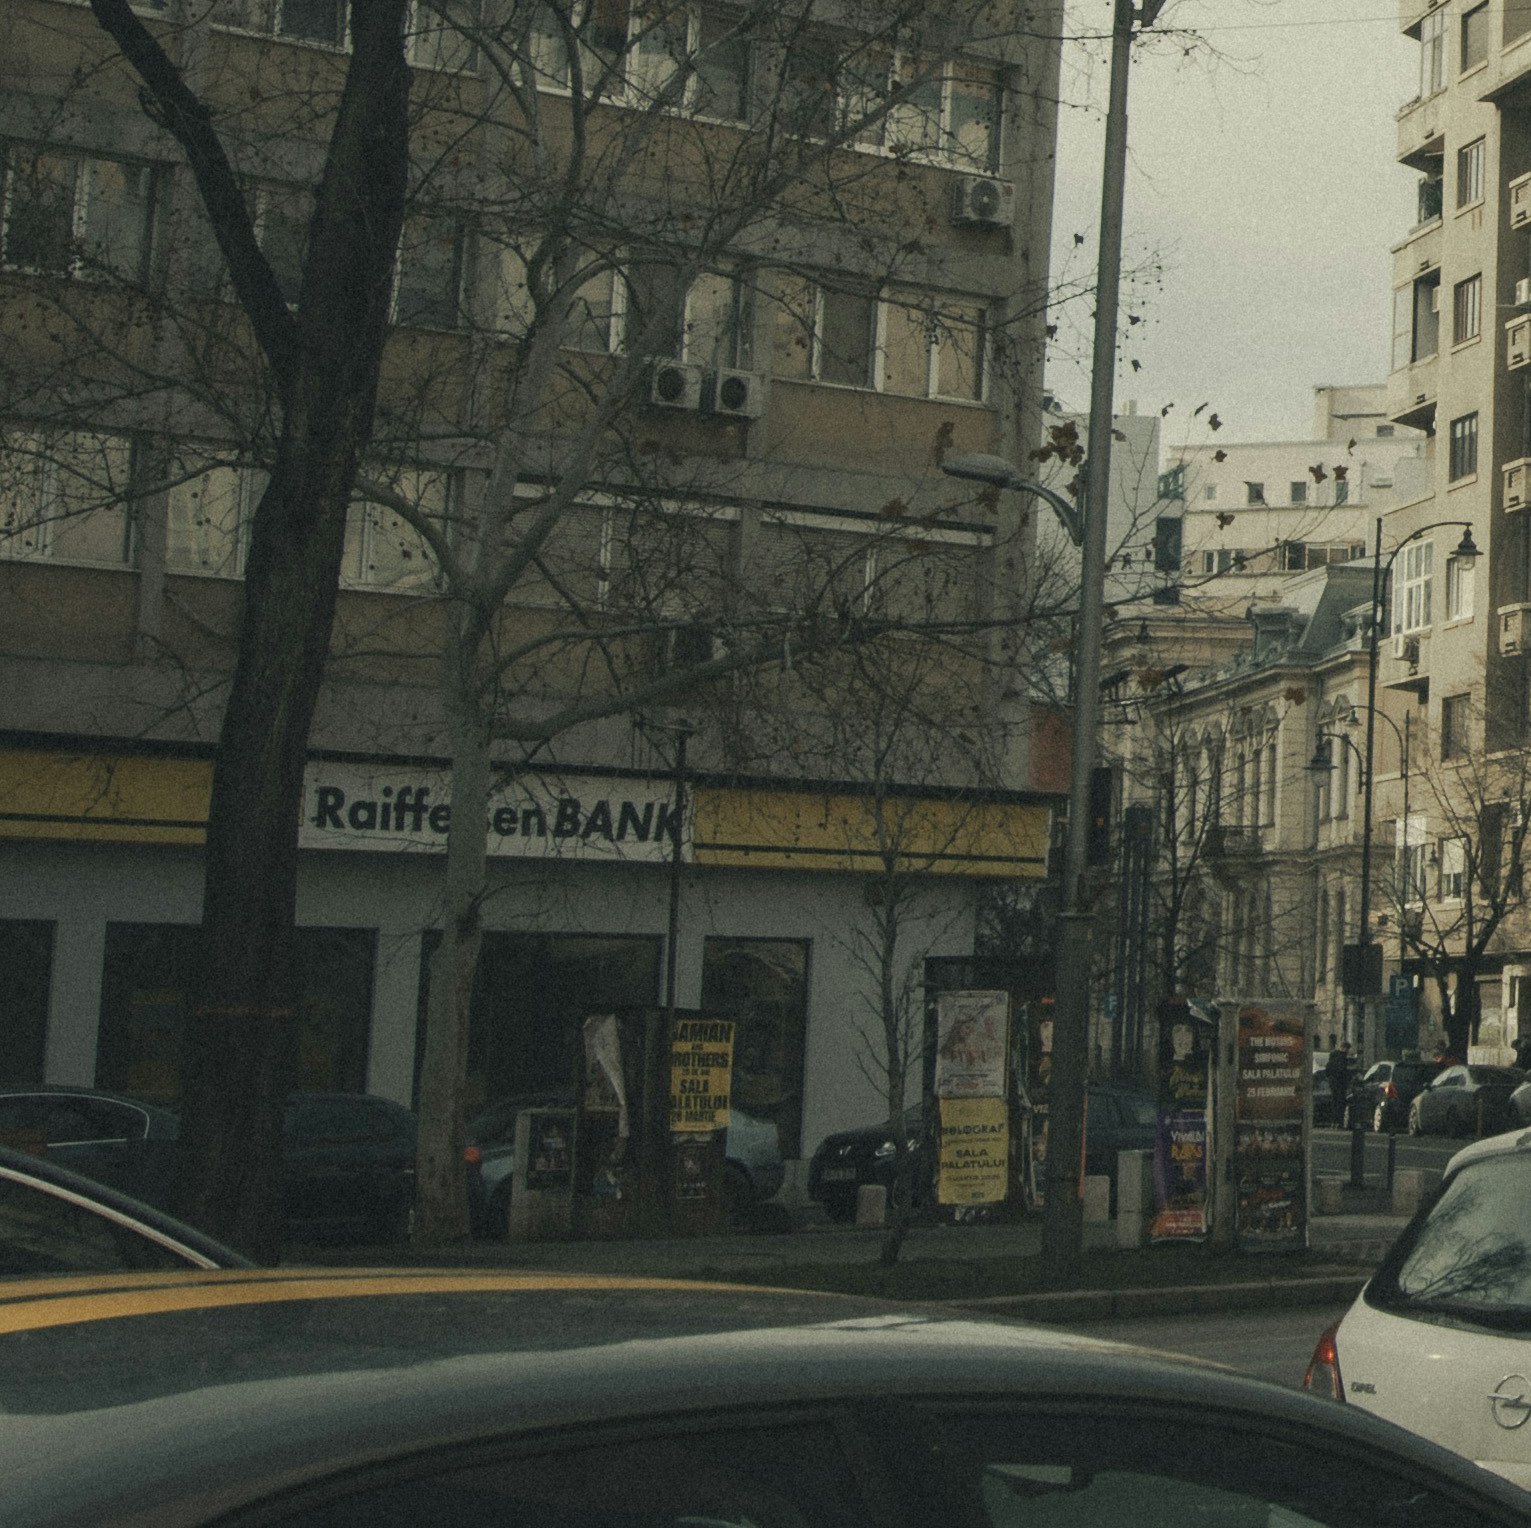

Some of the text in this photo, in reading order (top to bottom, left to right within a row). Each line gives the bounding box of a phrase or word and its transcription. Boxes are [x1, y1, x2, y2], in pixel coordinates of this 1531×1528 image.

[315, 785, 682, 843] Raiffeen BANK
[1395, 978, 1409, 997] P
[1242, 1069, 1262, 1080] SALA
[680, 1079, 709, 1093] SALA
[956, 1148, 988, 1158] SALA
